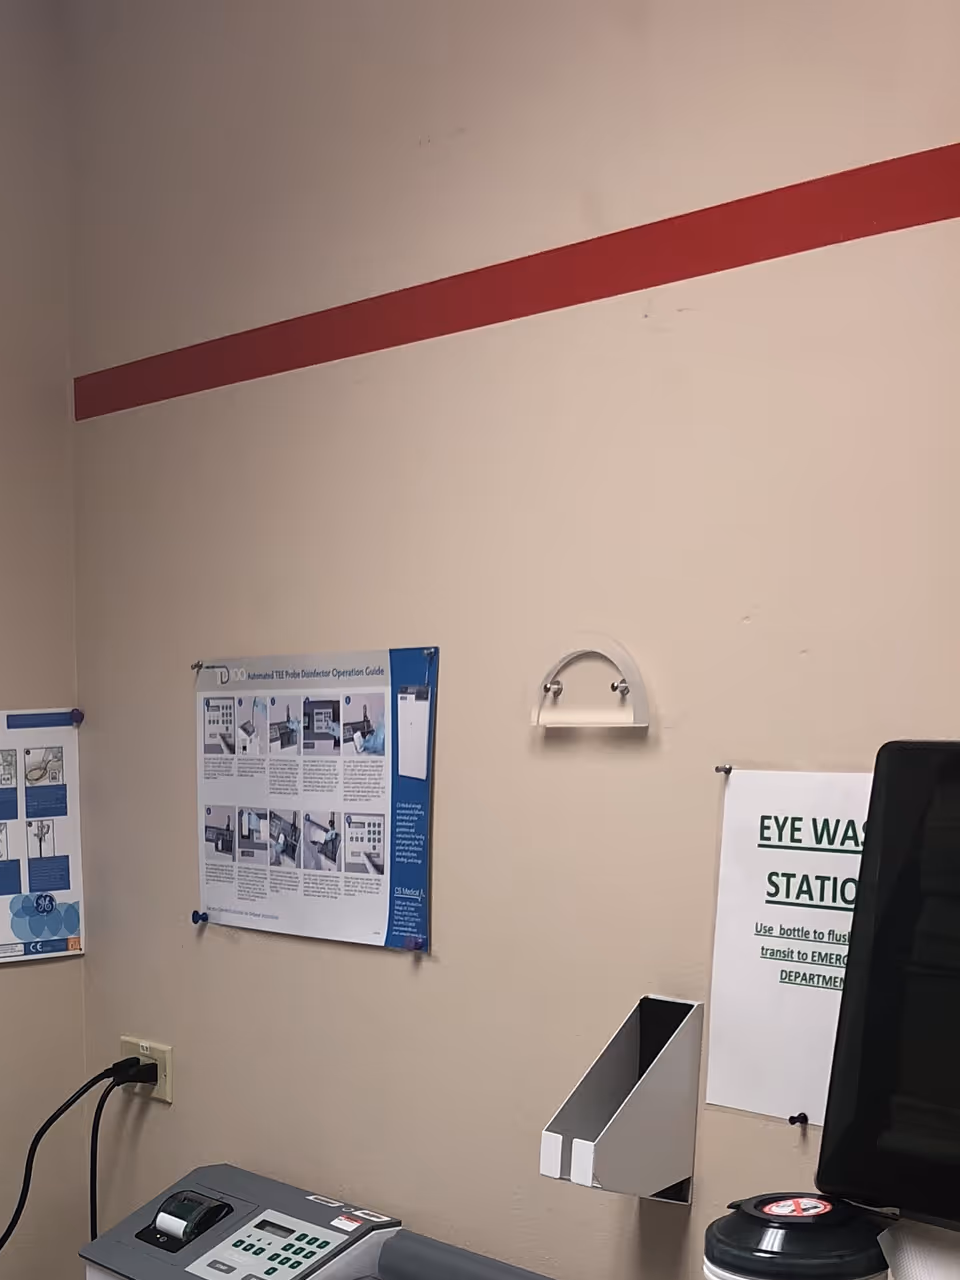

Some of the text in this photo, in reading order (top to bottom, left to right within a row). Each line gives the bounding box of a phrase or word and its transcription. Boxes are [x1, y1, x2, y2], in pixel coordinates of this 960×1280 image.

[247, 672, 274, 680] Automated
[274, 672, 284, 680] TEE
[285, 672, 300, 680] Probe
[332, 668, 364, 680] Operation
[365, 666, 384, 676] Guide
[759, 814, 867, 848] EYE WA
[755, 922, 774, 934] Use
[779, 924, 810, 939] bottle
[813, 929, 825, 941] to
[760, 945, 794, 960] transit
[797, 950, 808, 962] to
